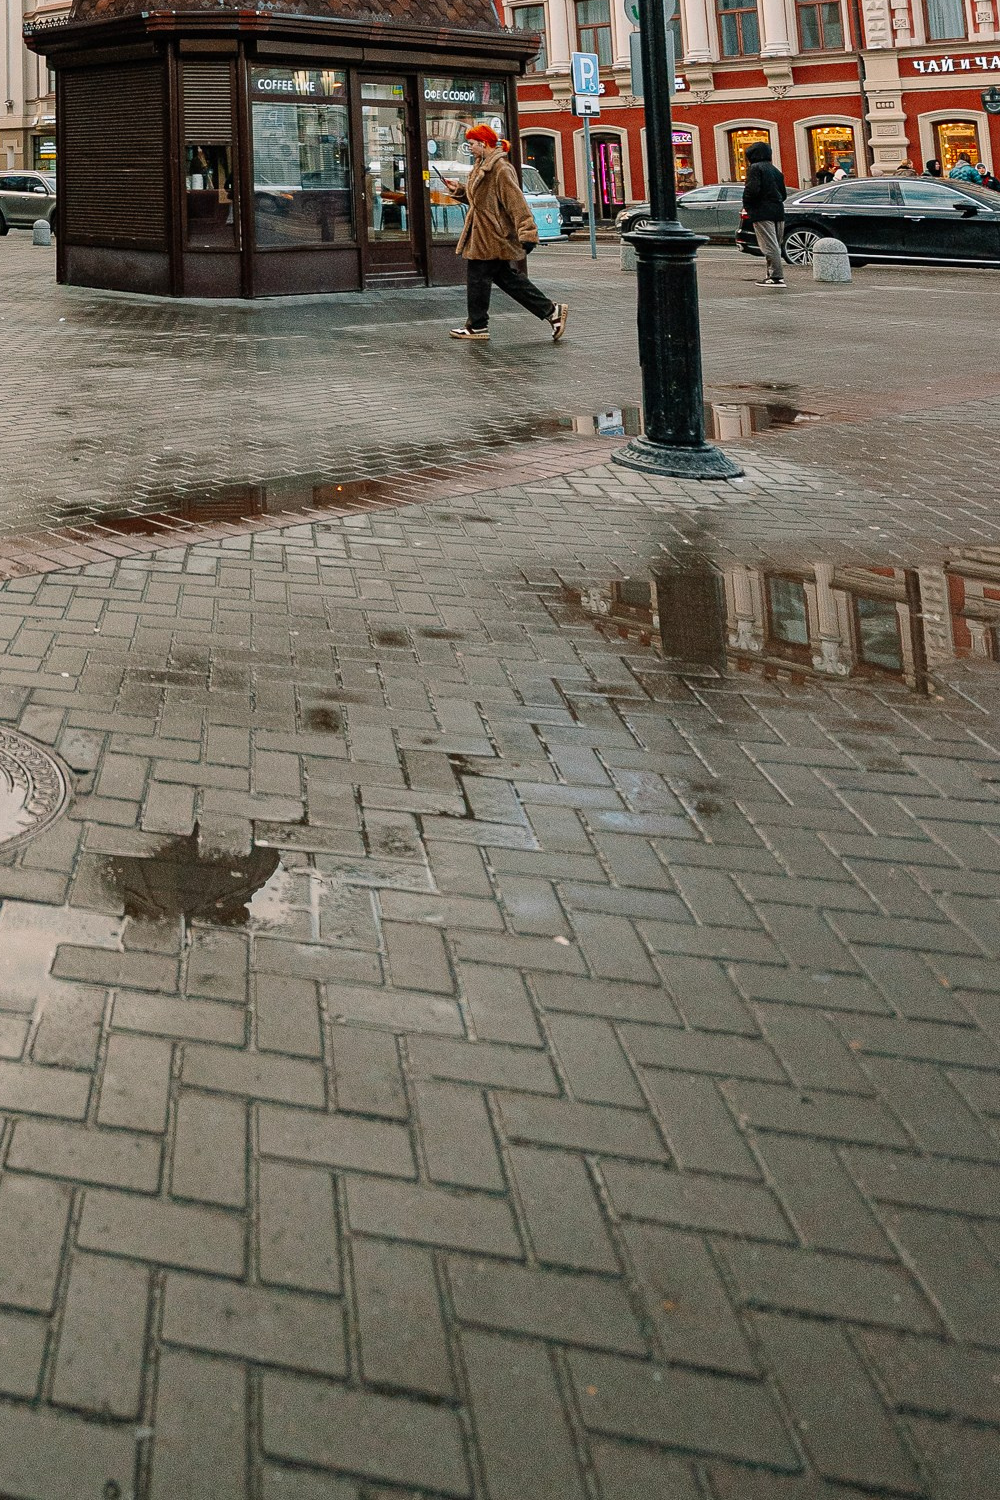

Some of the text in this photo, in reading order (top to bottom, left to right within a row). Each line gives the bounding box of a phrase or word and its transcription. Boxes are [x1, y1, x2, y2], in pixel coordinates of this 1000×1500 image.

[913, 56, 955, 72] ЧАЙ
[257, 78, 316, 92] COFFEE LIKE
[424, 89, 441, 100] ОФЕ
[449, 90, 475, 101] СОБОЙ
